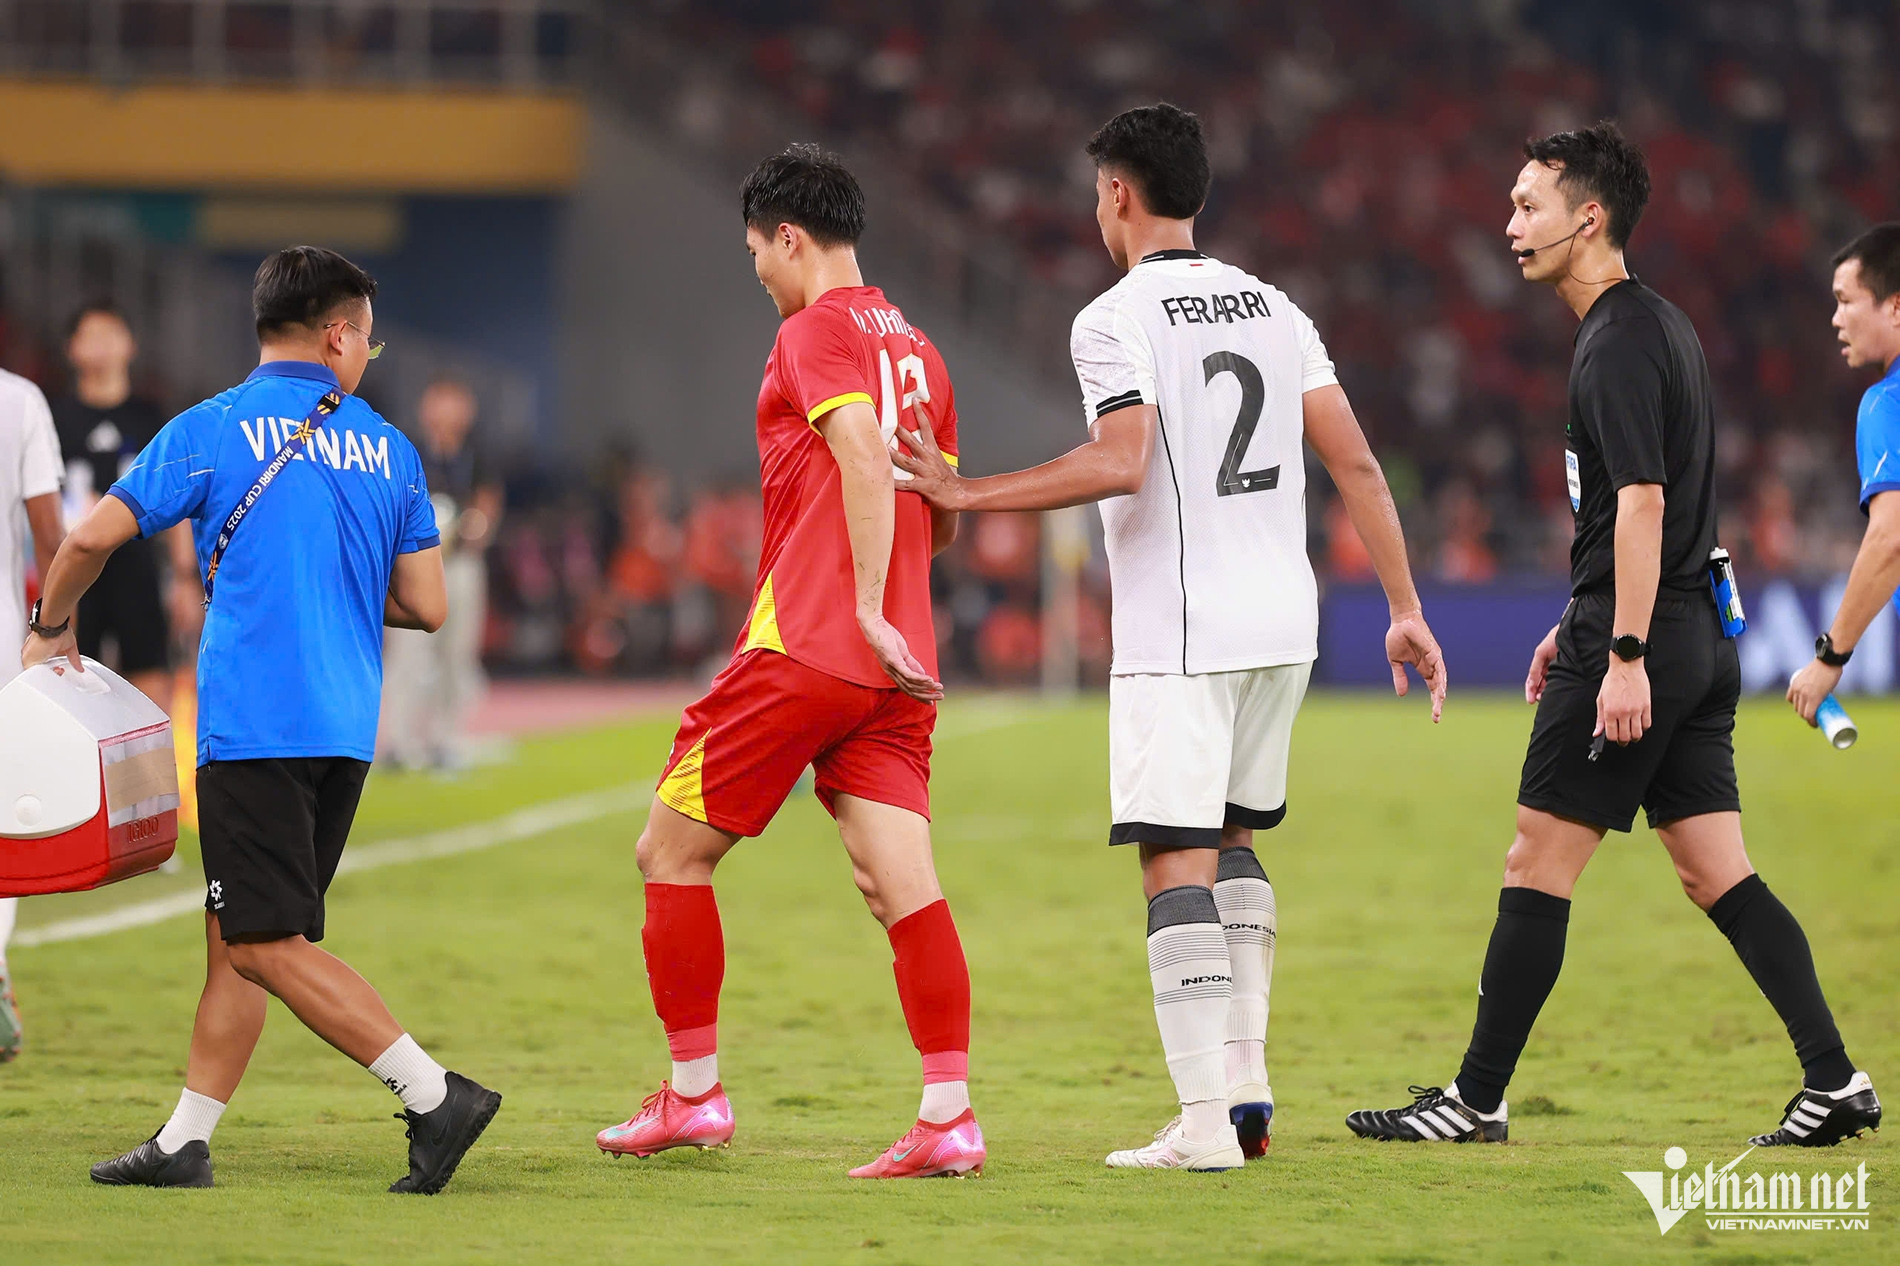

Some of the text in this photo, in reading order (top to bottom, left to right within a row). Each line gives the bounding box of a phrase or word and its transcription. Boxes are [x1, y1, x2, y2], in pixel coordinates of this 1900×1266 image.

[1161, 291, 1272, 327] FERARRI
[1202, 350, 1281, 498] 2
[226, 445, 294, 531] MANDIRI CUP 2025
